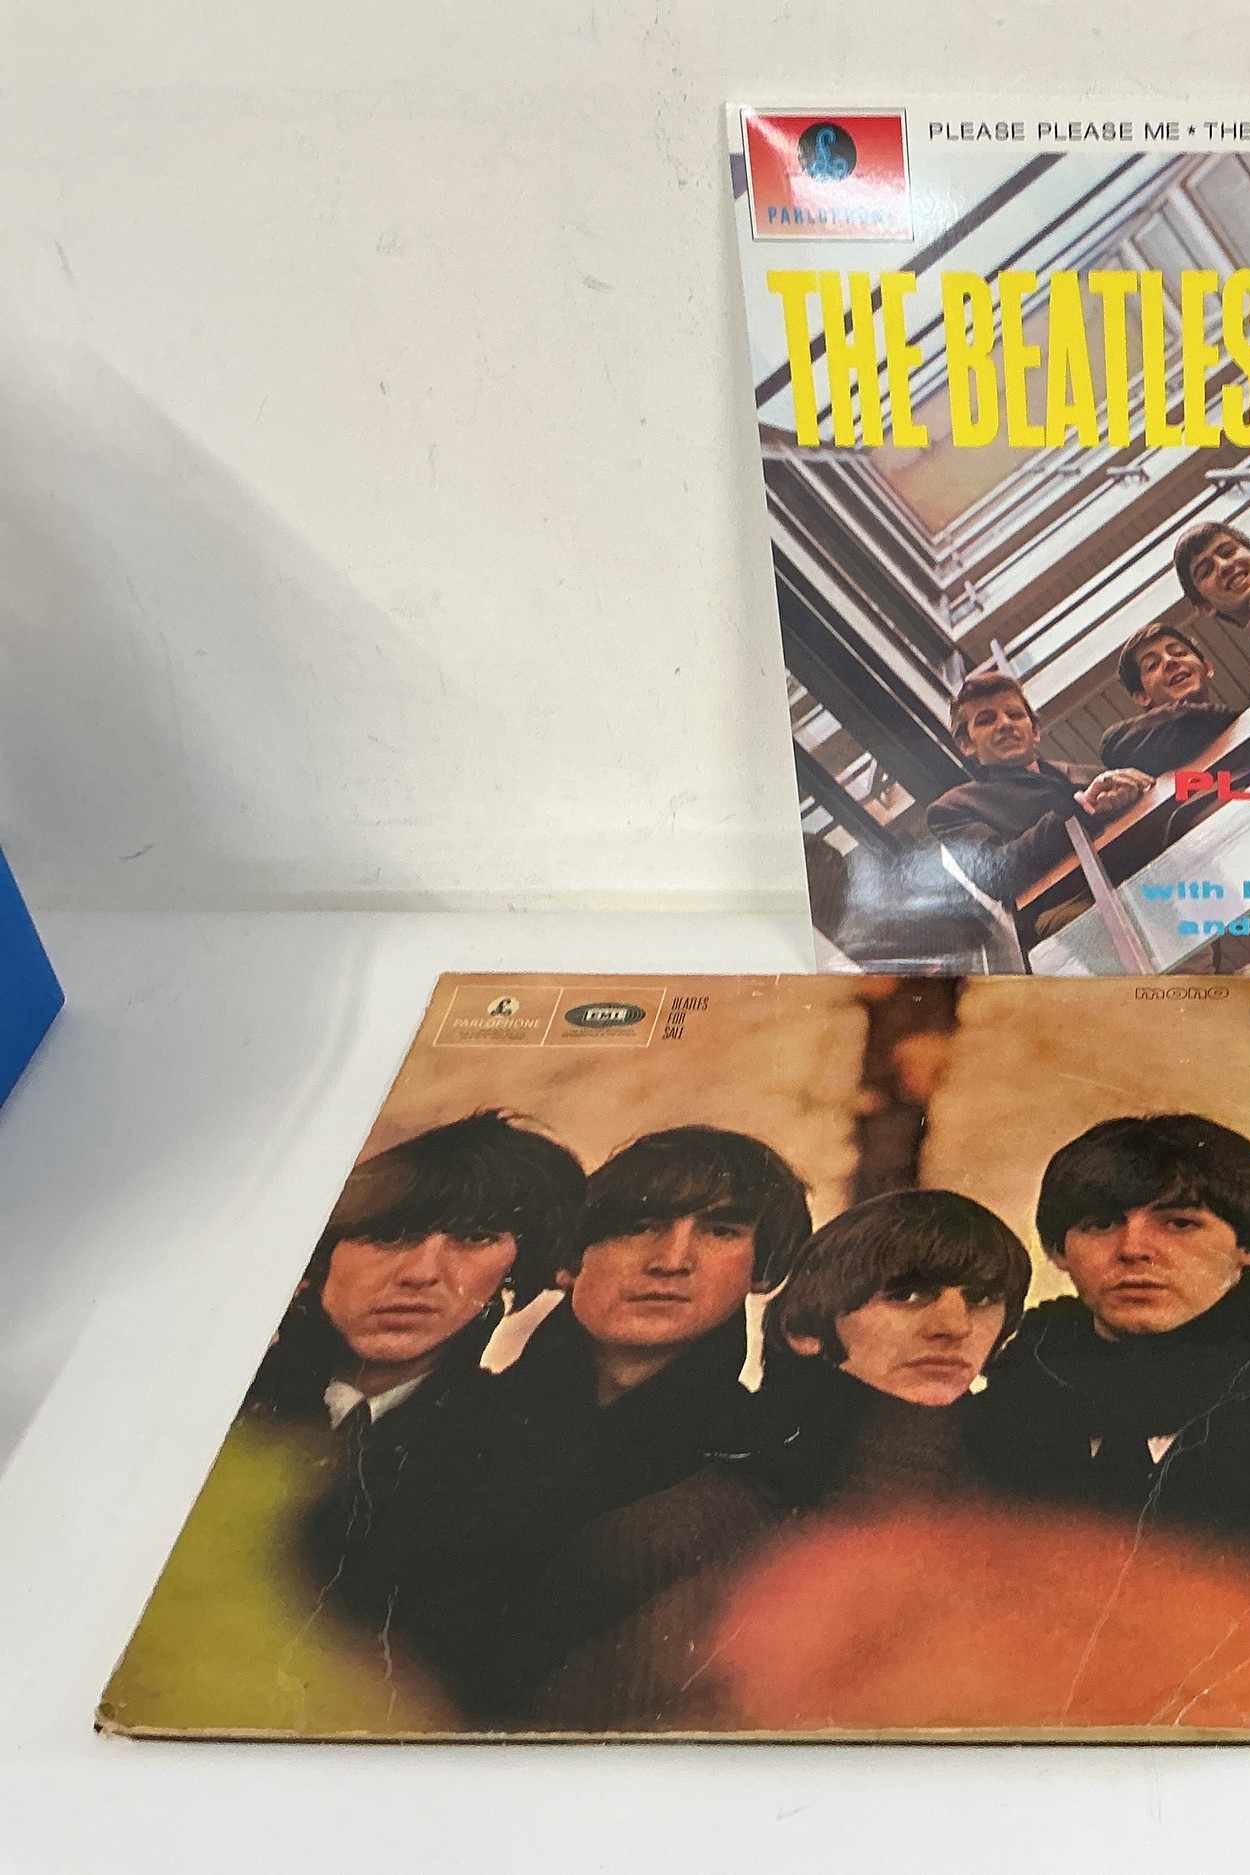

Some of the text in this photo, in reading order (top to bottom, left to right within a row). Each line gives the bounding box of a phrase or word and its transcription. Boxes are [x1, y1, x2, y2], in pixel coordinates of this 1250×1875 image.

[928, 121, 1026, 141] PLEASE
[1037, 121, 1134, 141] PLEASE
[1144, 121, 1180, 141] ME
[767, 269, 928, 448] THE
[1141, 880, 1225, 901] with
[1177, 914, 1250, 937] and
[1135, 986, 1230, 1001] mono
